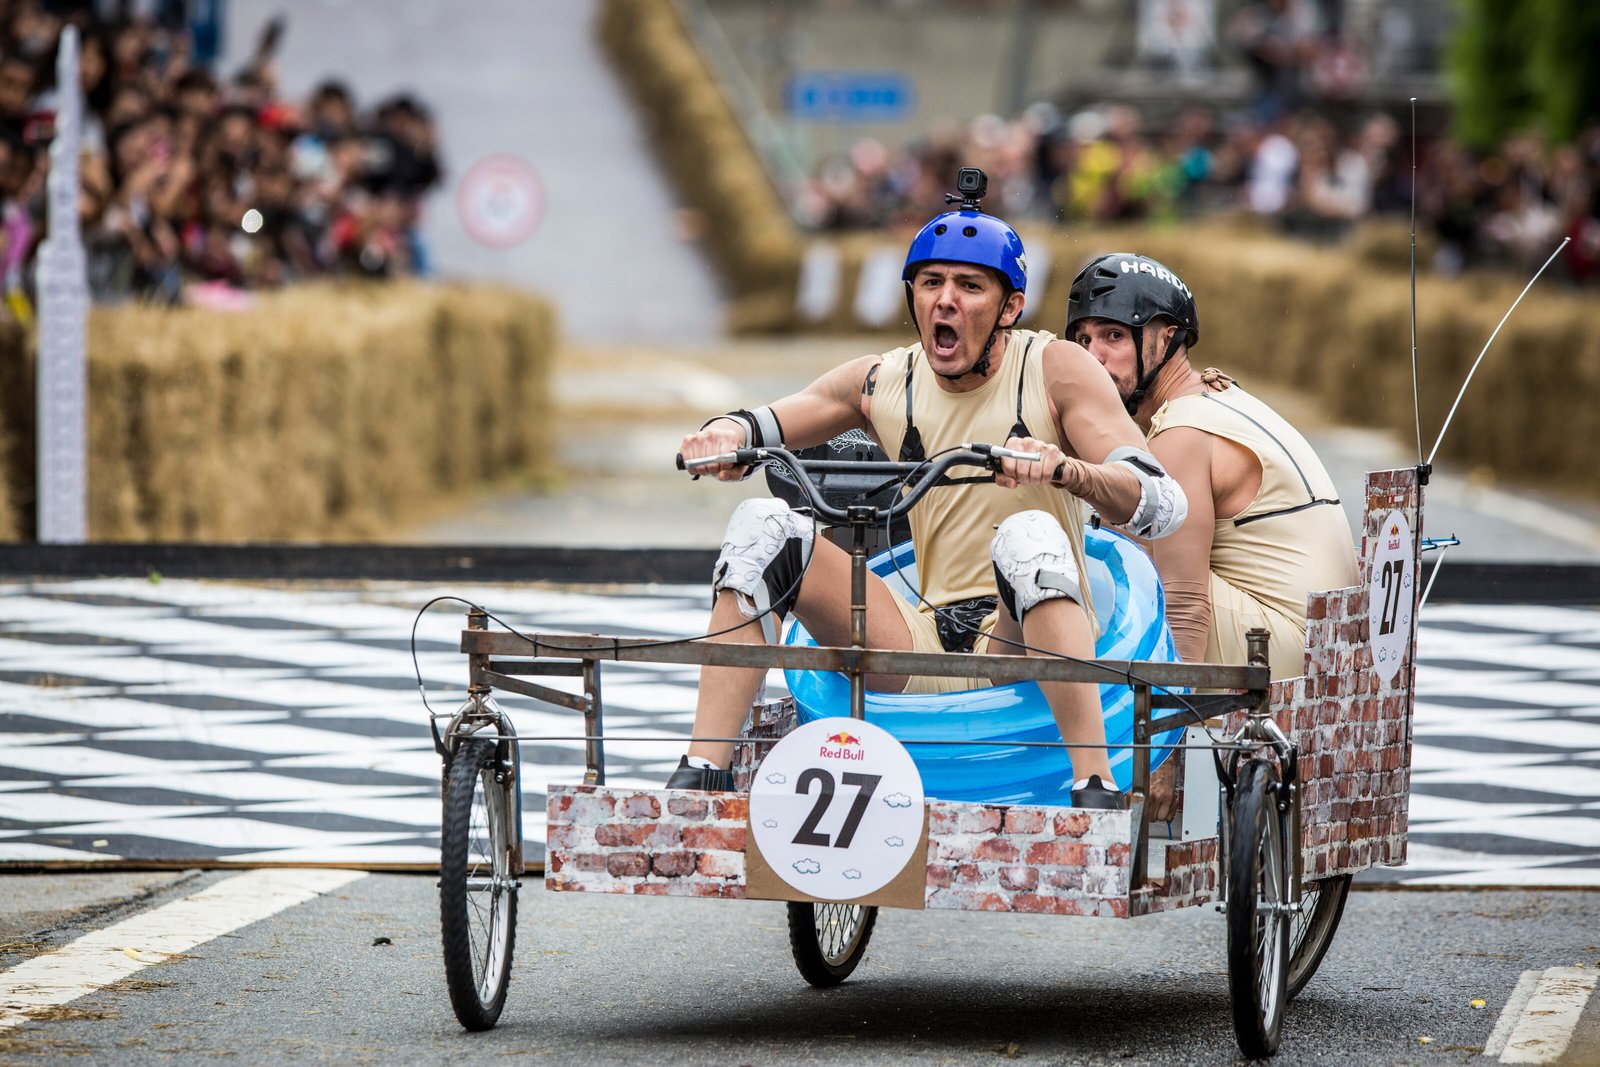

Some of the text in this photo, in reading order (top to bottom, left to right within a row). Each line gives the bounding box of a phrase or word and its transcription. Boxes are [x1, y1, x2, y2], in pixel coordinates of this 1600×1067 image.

[1379, 560, 1404, 635] 27
[820, 746, 864, 761] Red Bull
[791, 768, 882, 849] 27
